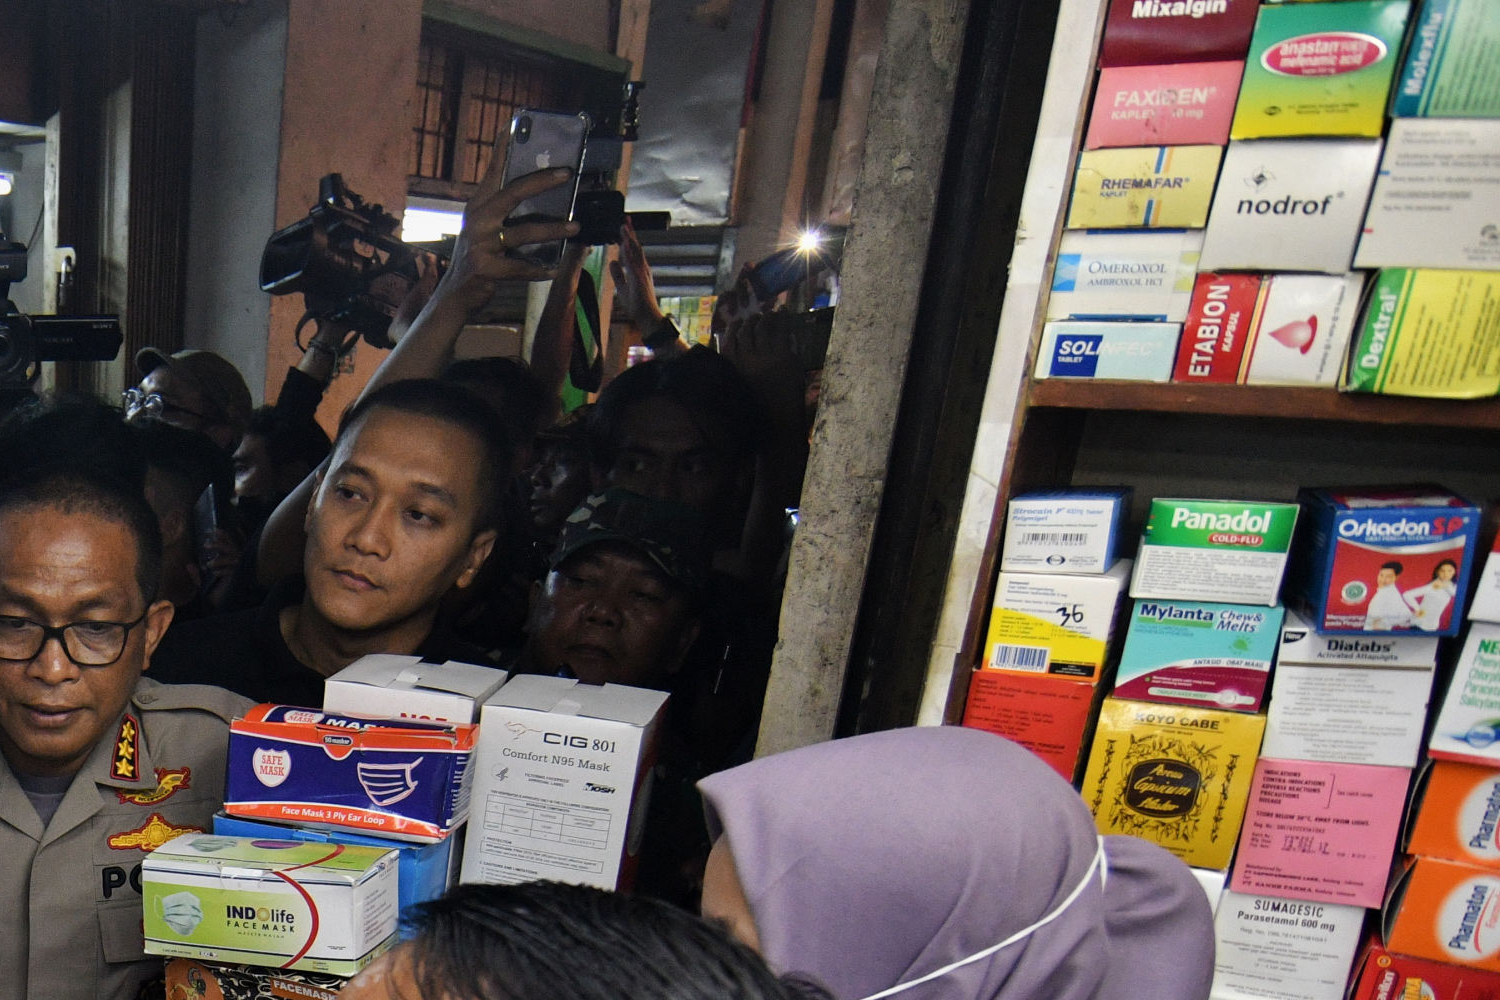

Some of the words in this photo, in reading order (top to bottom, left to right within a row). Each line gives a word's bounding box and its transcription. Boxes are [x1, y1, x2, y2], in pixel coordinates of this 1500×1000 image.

[1132, 0, 1227, 18] Mixalgin
[1280, 40, 1340, 57] anastan
[1101, 177, 1184, 190] RHEMAFAR
[1237, 195, 1332, 215] nodrof
[1088, 278, 1142, 287] AMBROXOL
[1188, 284, 1231, 377] ETABION
[1222, 312, 1240, 352] KAPSUL
[1171, 507, 1272, 533] Panadol
[1339, 518, 1430, 536] Oskadon
[1432, 516, 1464, 536] SP
[1140, 603, 1214, 622] Mylanta
[1216, 620, 1256, 633] Melts
[1285, 632, 1302, 640] New
[1327, 640, 1391, 652] Diatabs
[1478, 639, 1500, 655] NE
[1317, 651, 1353, 660] Activated
[1180, 717, 1220, 730] CABE
[543, 732, 589, 748] CIG
[592, 739, 616, 754] 801
[261, 753, 283, 766] SAFE
[502, 747, 548, 764] Comfort
[551, 755, 575, 767] N95
[577, 757, 611, 772] Mask
[259, 765, 285, 777] MASK
[281, 806, 300, 816] Face
[302, 807, 324, 818] Mask
[326, 810, 331, 819] 3
[333, 810, 346, 822] Ply
[348, 813, 361, 823] Ear
[363, 813, 385, 826] Loop
[226, 905, 295, 924] INDOlife
[1254, 899, 1324, 919] SUMAGESIC
[1449, 884, 1488, 950] Pharmaton
[227, 920, 257, 930] FACE
[262, 923, 295, 933] MASK
[1320, 921, 1335, 933] mg
